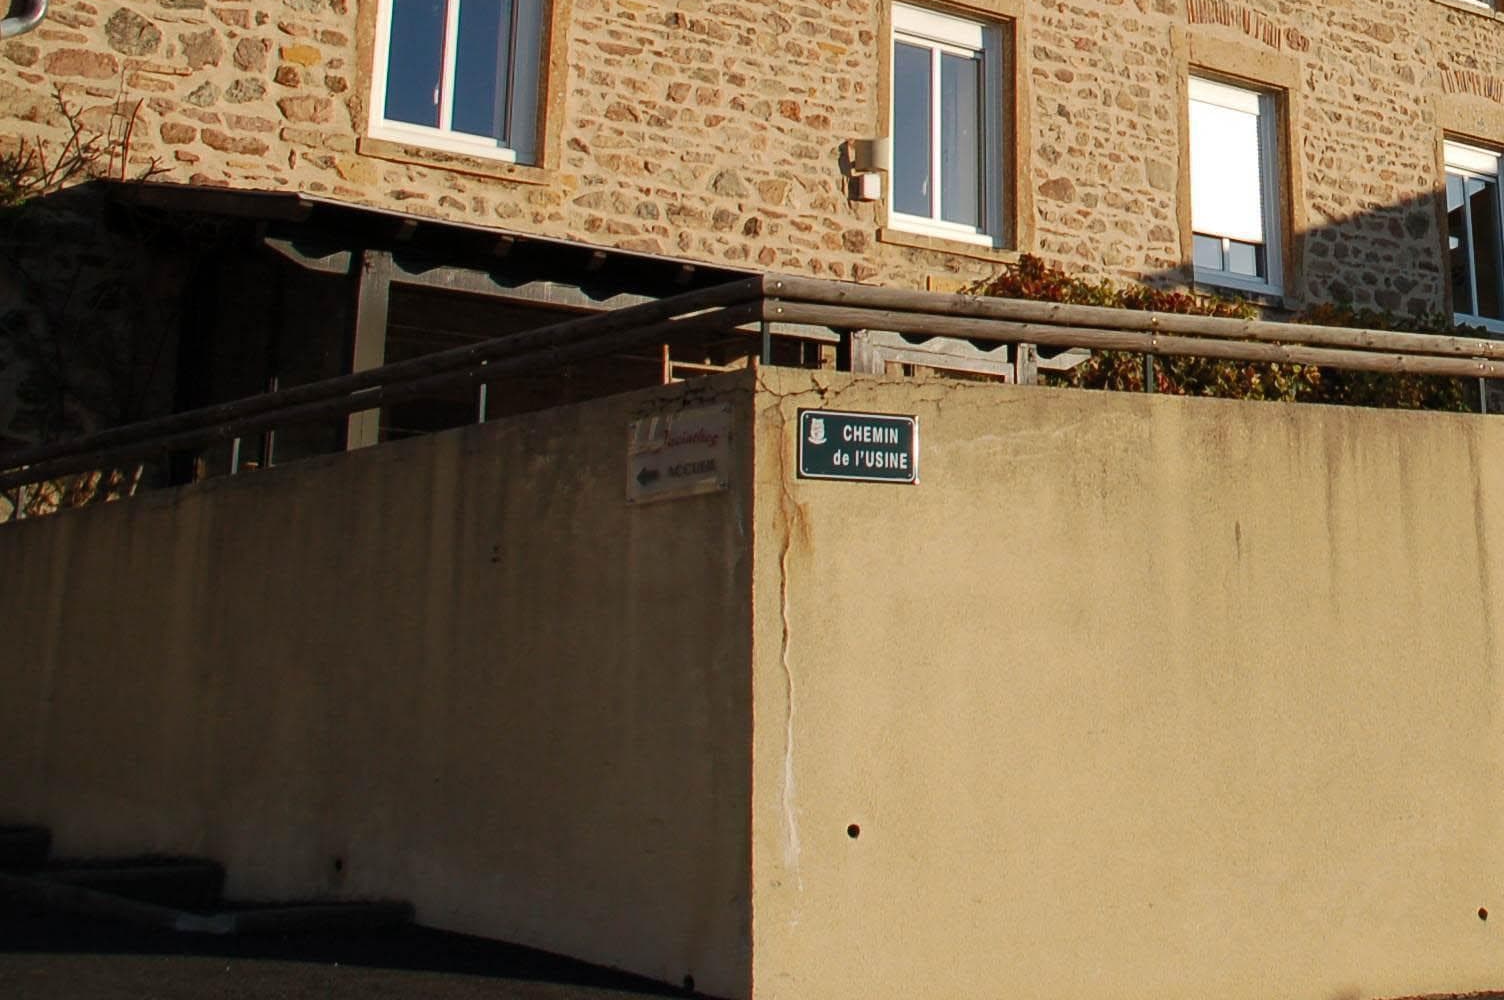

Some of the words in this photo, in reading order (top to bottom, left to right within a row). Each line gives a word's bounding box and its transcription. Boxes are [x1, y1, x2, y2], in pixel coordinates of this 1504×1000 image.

[843, 425, 898, 444] CHEMIN
[833, 449, 849, 466] de
[855, 450, 908, 469] l'USINE
